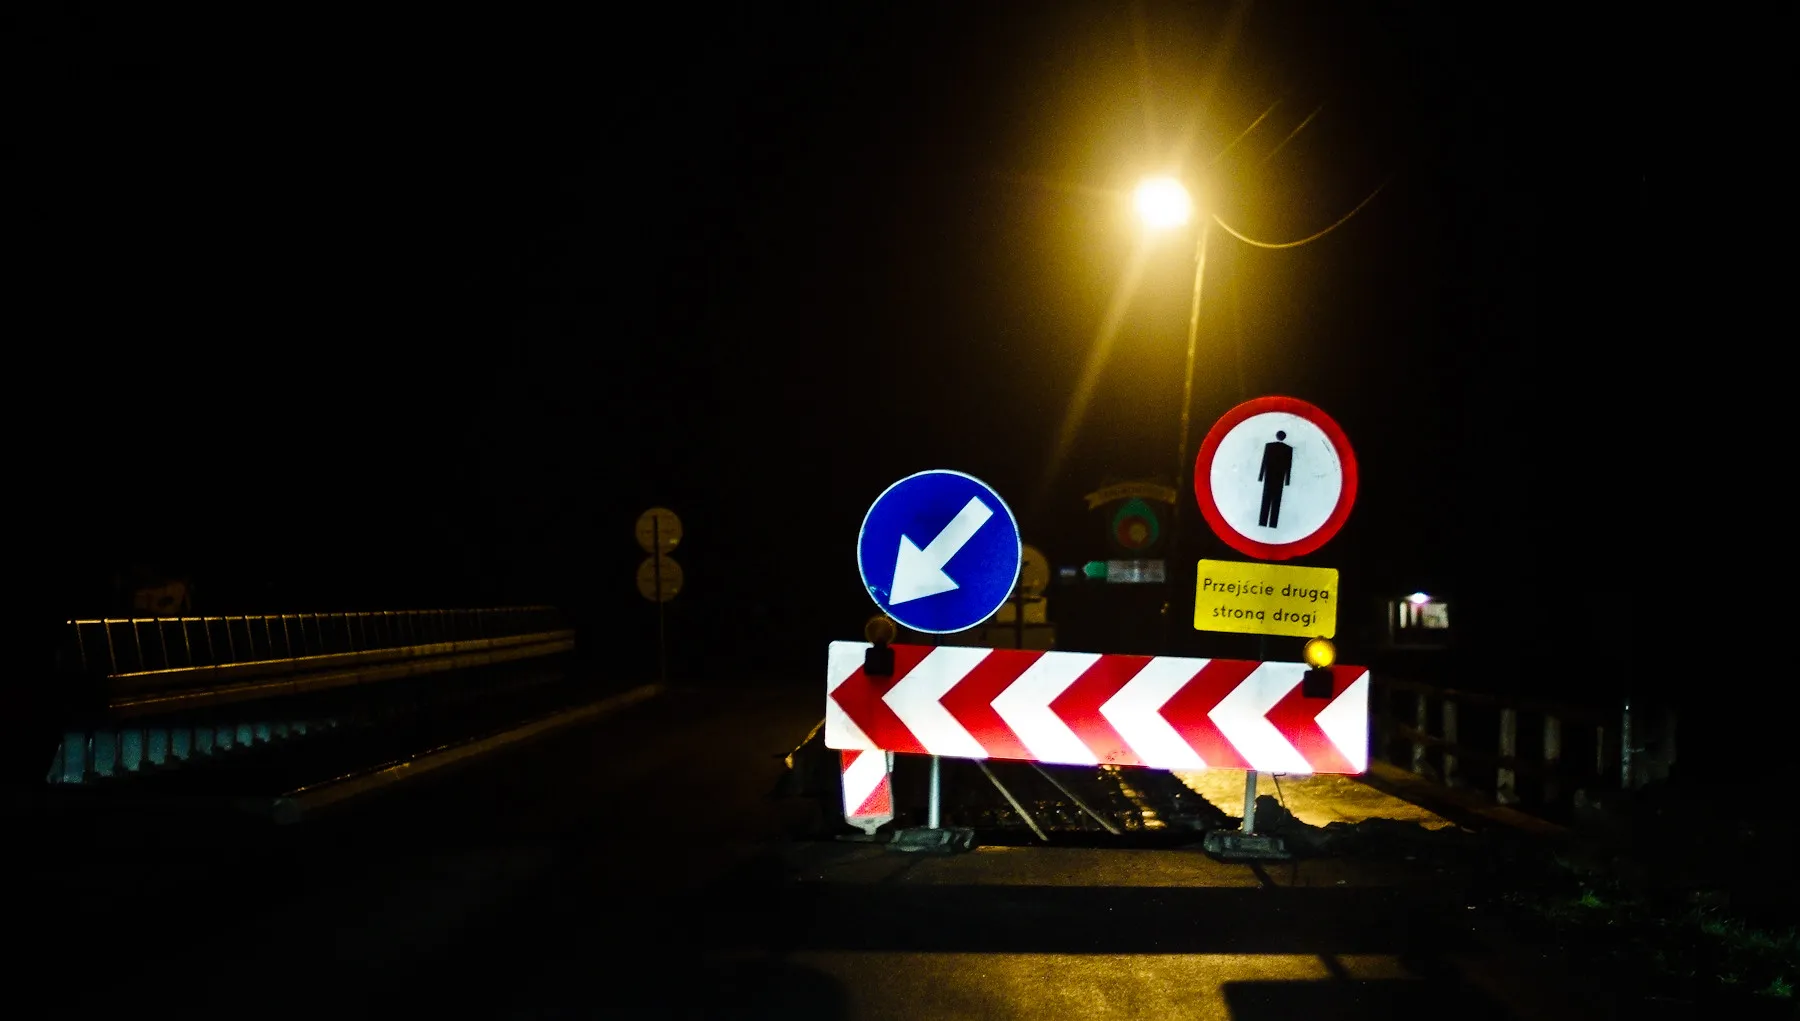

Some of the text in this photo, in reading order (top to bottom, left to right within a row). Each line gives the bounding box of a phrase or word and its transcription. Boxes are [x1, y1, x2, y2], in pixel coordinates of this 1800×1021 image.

[1203, 578, 1329, 604] Przejście drugą
[1212, 604, 1317, 627] stroną drogi
